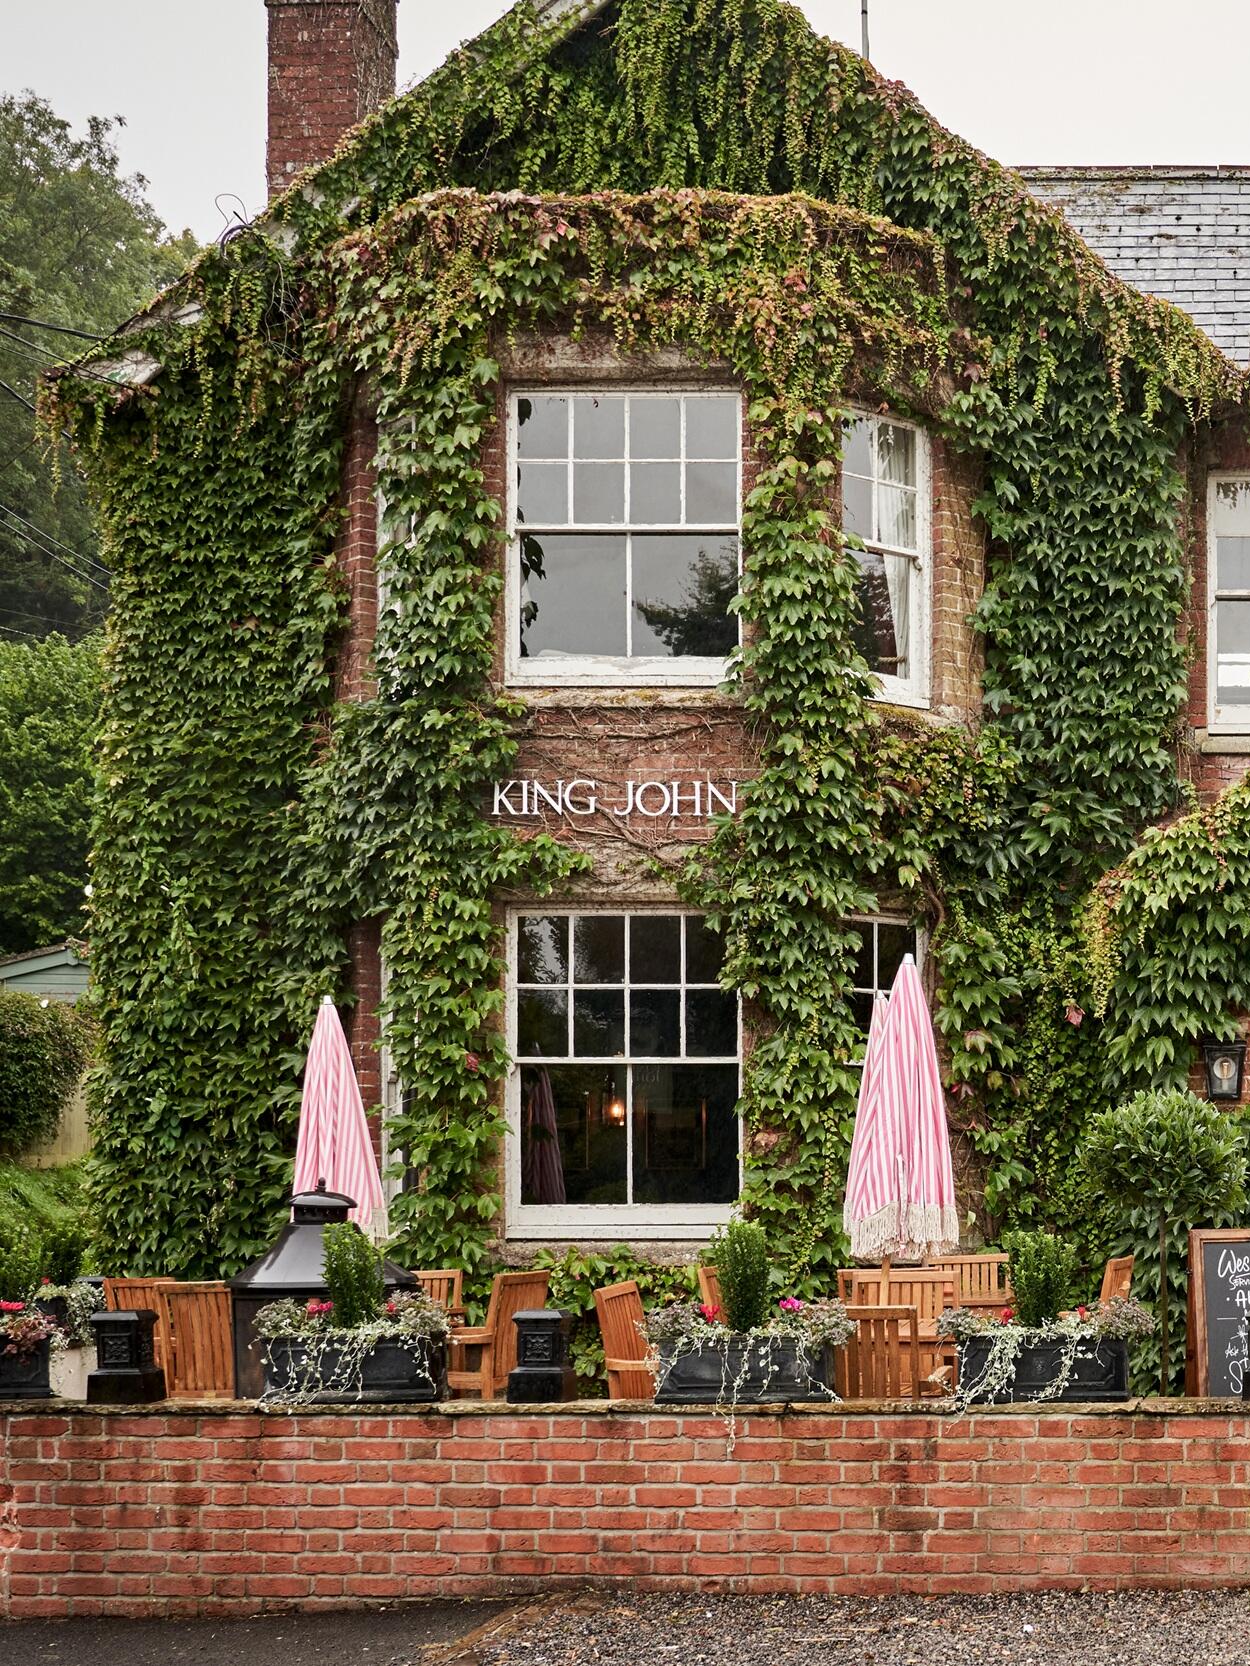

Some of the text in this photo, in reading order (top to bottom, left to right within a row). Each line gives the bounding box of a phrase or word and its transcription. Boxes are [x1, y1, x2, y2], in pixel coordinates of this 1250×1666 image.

[491, 779, 739, 817] KING JOHN
[1217, 1249, 1250, 1278] Wes
